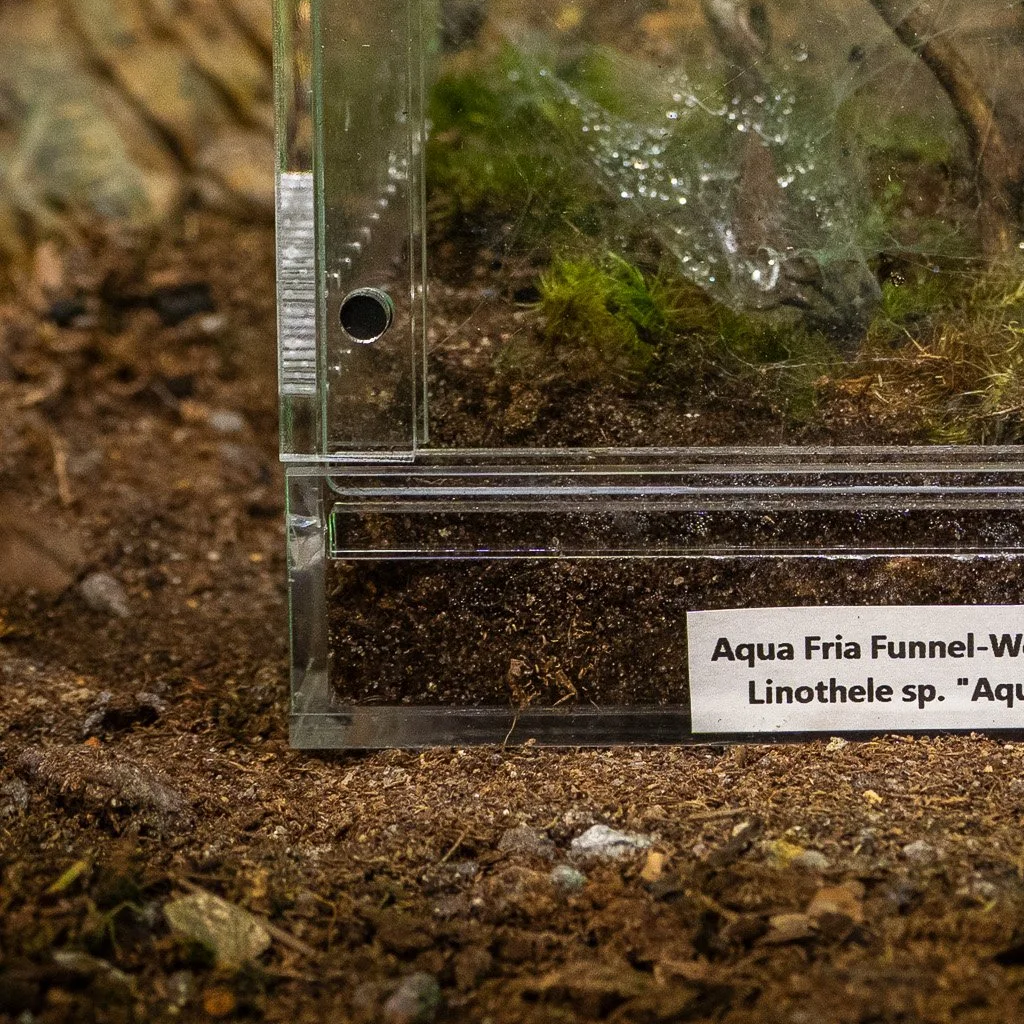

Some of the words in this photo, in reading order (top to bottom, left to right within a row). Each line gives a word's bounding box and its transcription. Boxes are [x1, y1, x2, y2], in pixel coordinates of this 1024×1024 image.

[710, 637, 795, 668] Aqua
[804, 634, 862, 661] Fria
[748, 677, 894, 705] Linothele
[901, 684, 946, 710] sp.
